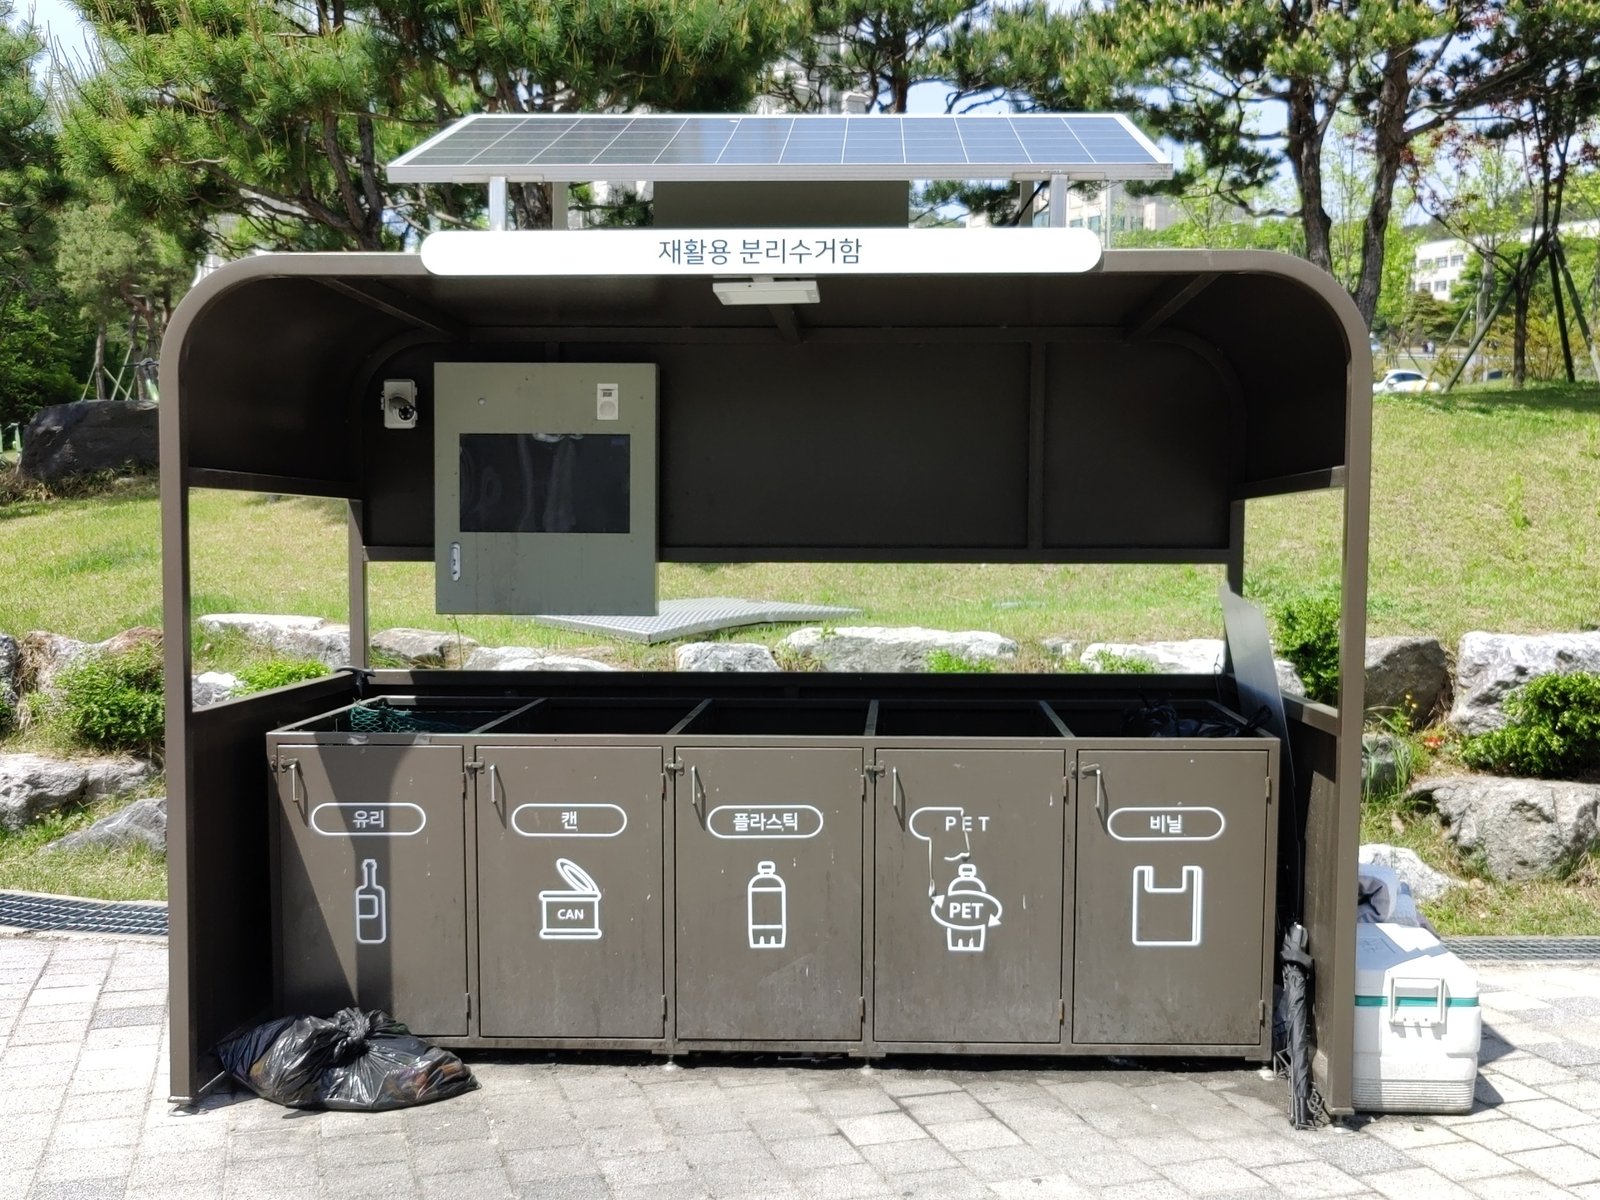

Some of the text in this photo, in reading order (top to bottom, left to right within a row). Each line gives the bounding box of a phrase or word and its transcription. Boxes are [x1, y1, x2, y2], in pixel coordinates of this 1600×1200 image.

[658, 238, 862, 265] 재활용 분리수거함
[352, 809, 385, 829] 유리
[561, 810, 578, 830] 캔
[733, 812, 798, 832] 플라스틱
[945, 816, 990, 832] PET
[1149, 814, 1183, 834] 비닐
[557, 907, 585, 921] CAN
[949, 902, 984, 919] PET
